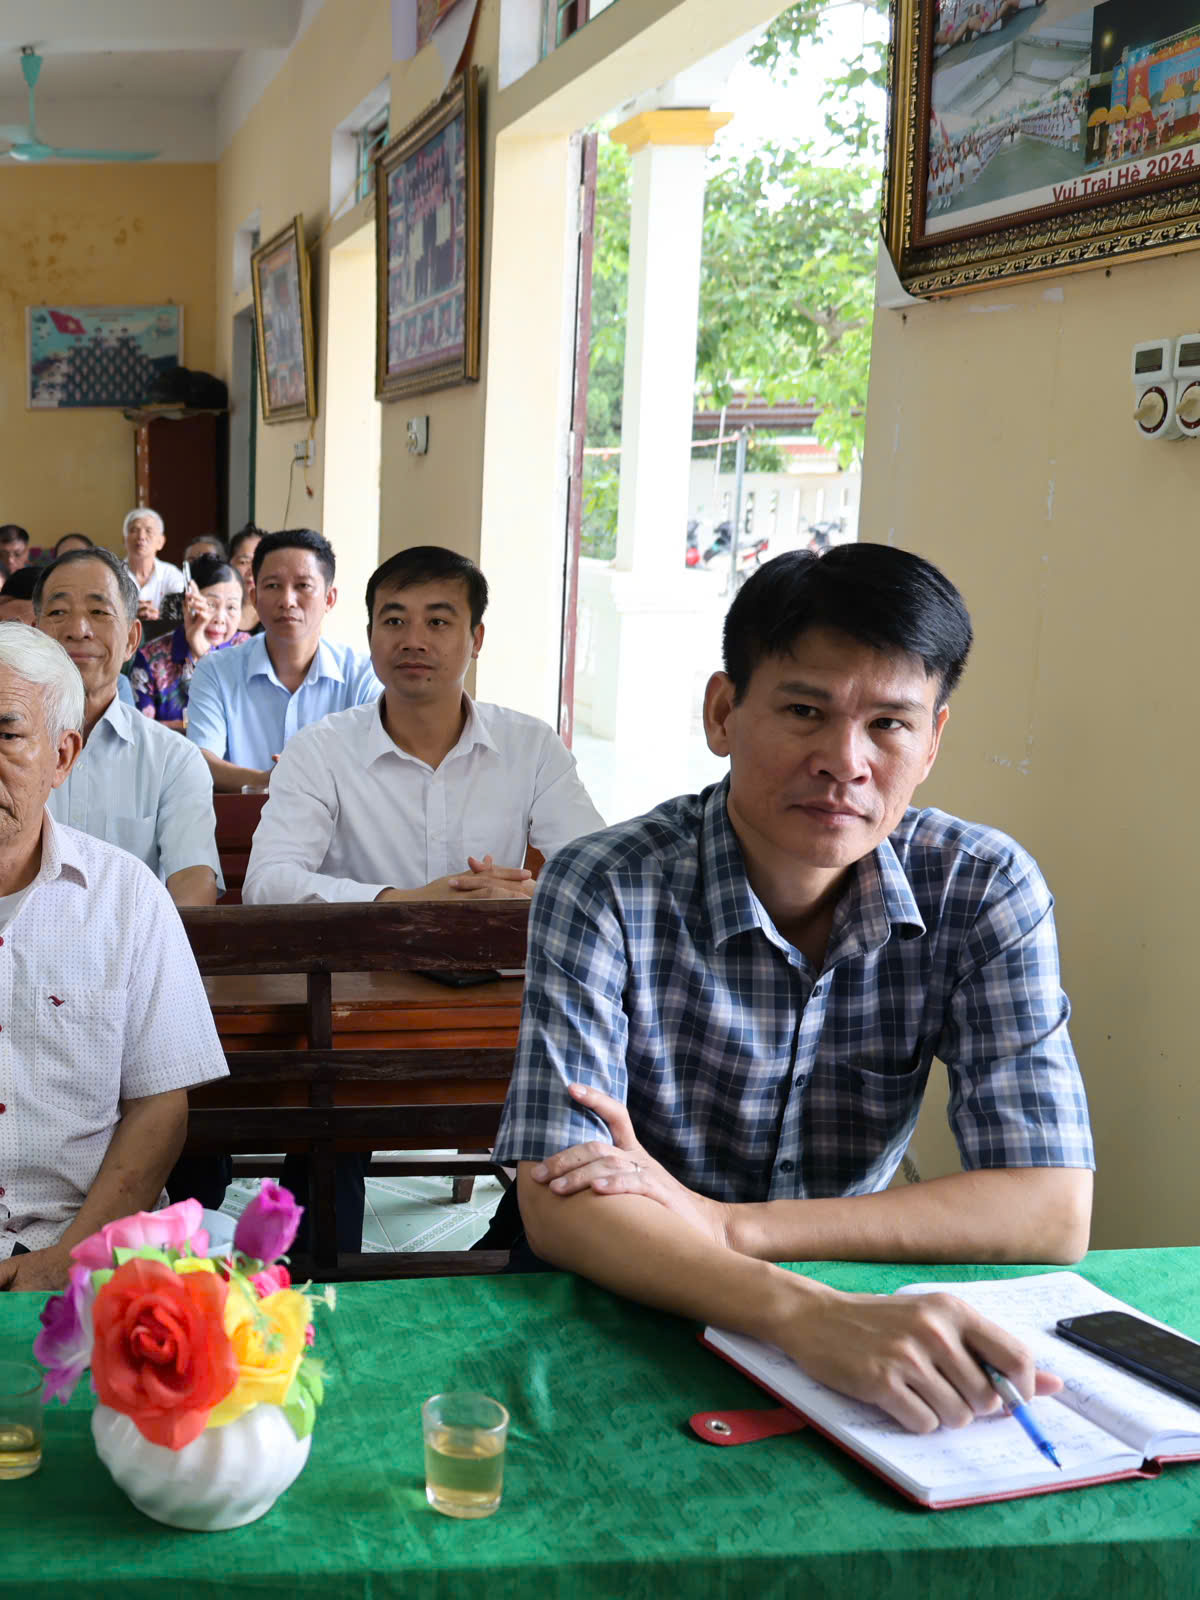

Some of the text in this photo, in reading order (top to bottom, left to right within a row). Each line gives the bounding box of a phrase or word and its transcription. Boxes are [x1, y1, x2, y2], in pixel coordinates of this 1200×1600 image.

[1053, 181, 1078, 200] Vui
[1117, 165, 1141, 186] Hè
[1146, 149, 1194, 177] 2024
